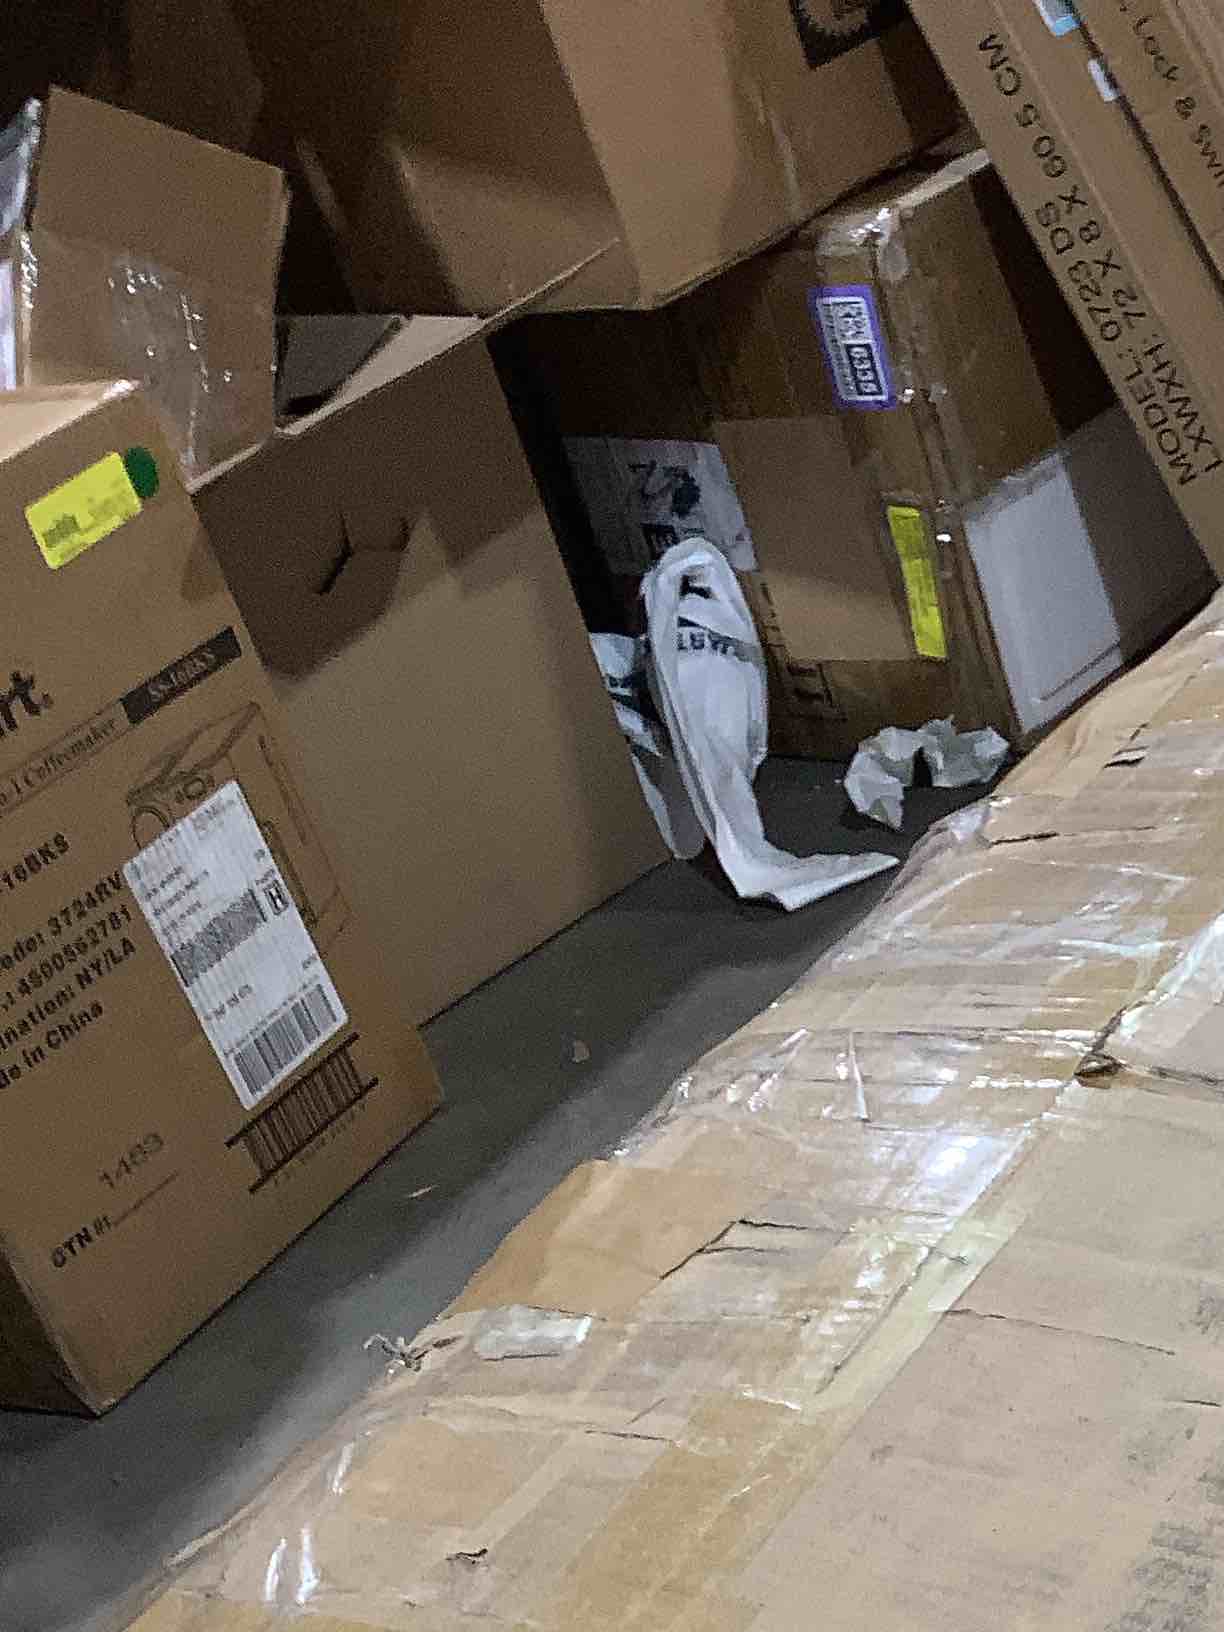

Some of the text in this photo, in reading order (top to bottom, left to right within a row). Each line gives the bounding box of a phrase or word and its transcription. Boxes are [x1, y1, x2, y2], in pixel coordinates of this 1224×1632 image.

[978, 33, 1022, 97] CM
[1175, 96, 1197, 120] &
[1079, 219, 1101, 245] 8
[1067, 259, 1121, 342] 0723
[1111, 287, 1148, 329] 72
[1117, 348, 1198, 486] MODEL:
[75, 936, 136, 991] NY/LA
[46, 1000, 104, 1050] China
